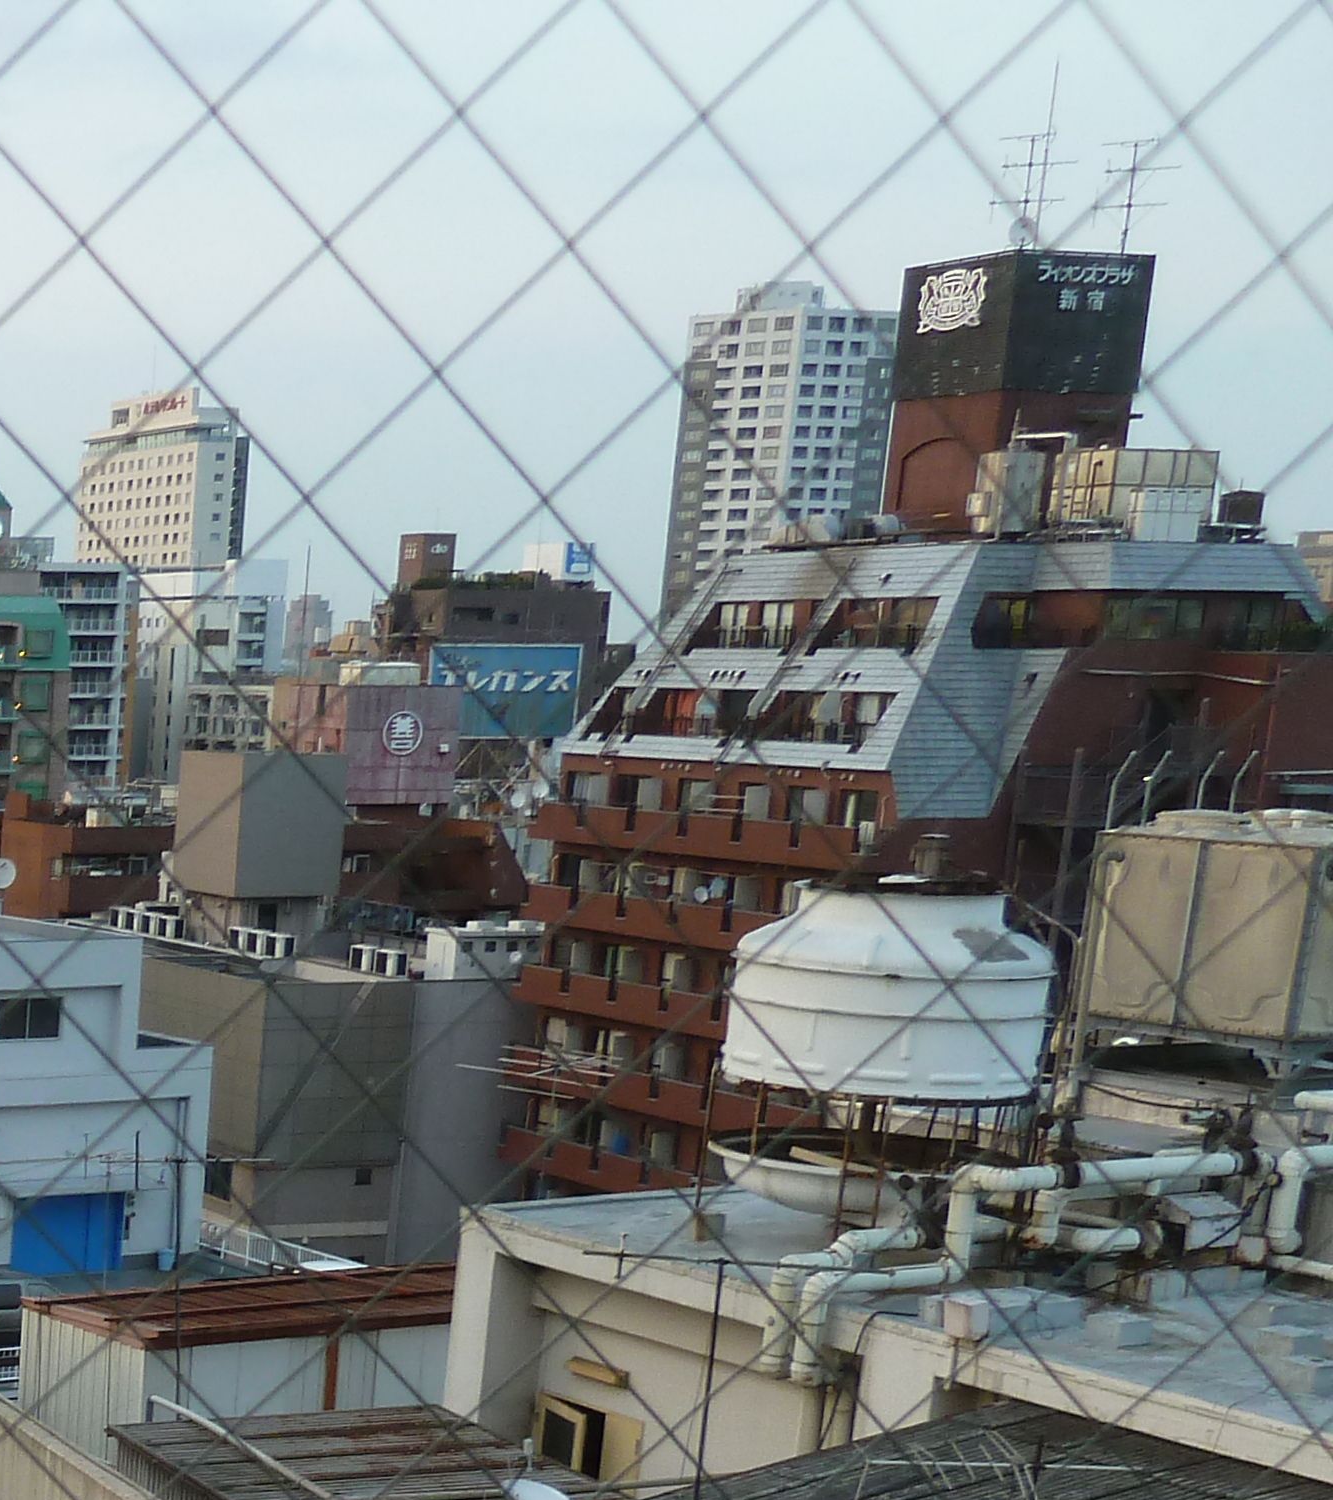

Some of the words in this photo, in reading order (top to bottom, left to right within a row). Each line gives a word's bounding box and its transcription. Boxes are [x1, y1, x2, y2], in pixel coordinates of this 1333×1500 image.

[1038, 260, 1137, 286] ライオンズプラザ
[1058, 289, 1105, 312] 新宿
